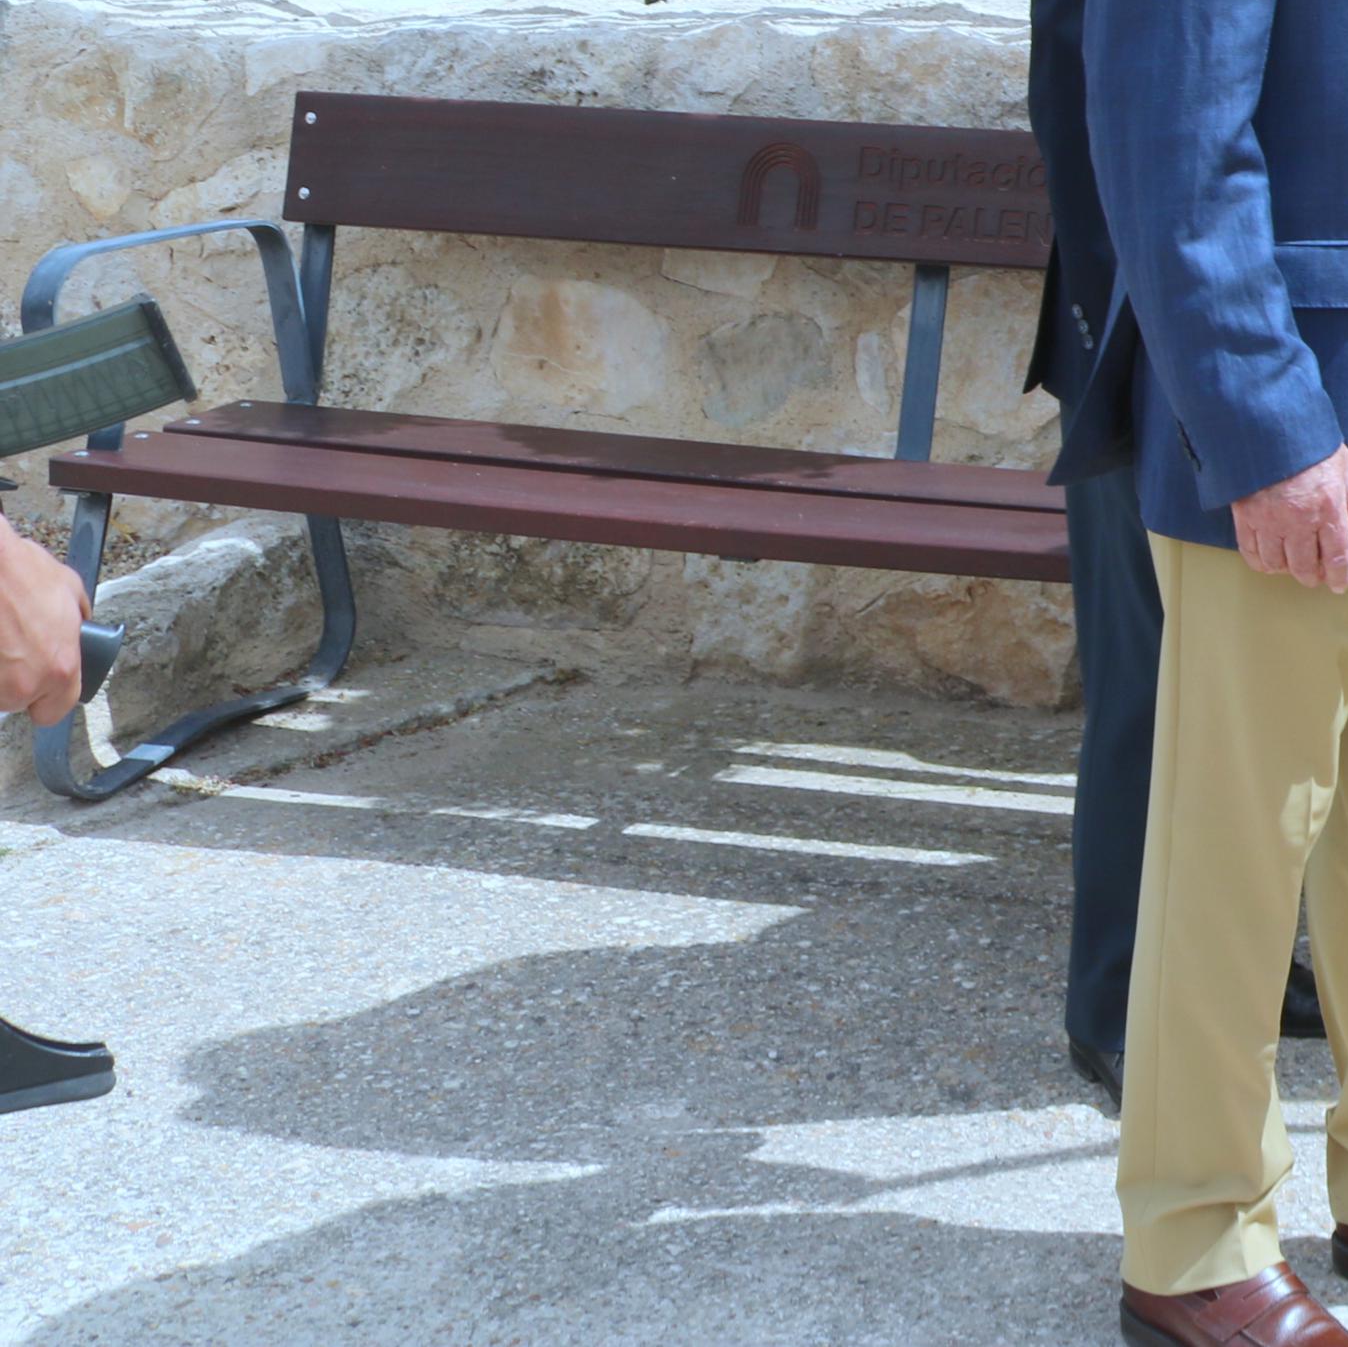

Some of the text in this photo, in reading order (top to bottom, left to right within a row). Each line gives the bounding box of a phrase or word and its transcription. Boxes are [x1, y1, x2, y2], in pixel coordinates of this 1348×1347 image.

[858, 145, 1047, 191] Diputació
[854, 201, 1052, 248] DE PALEN
